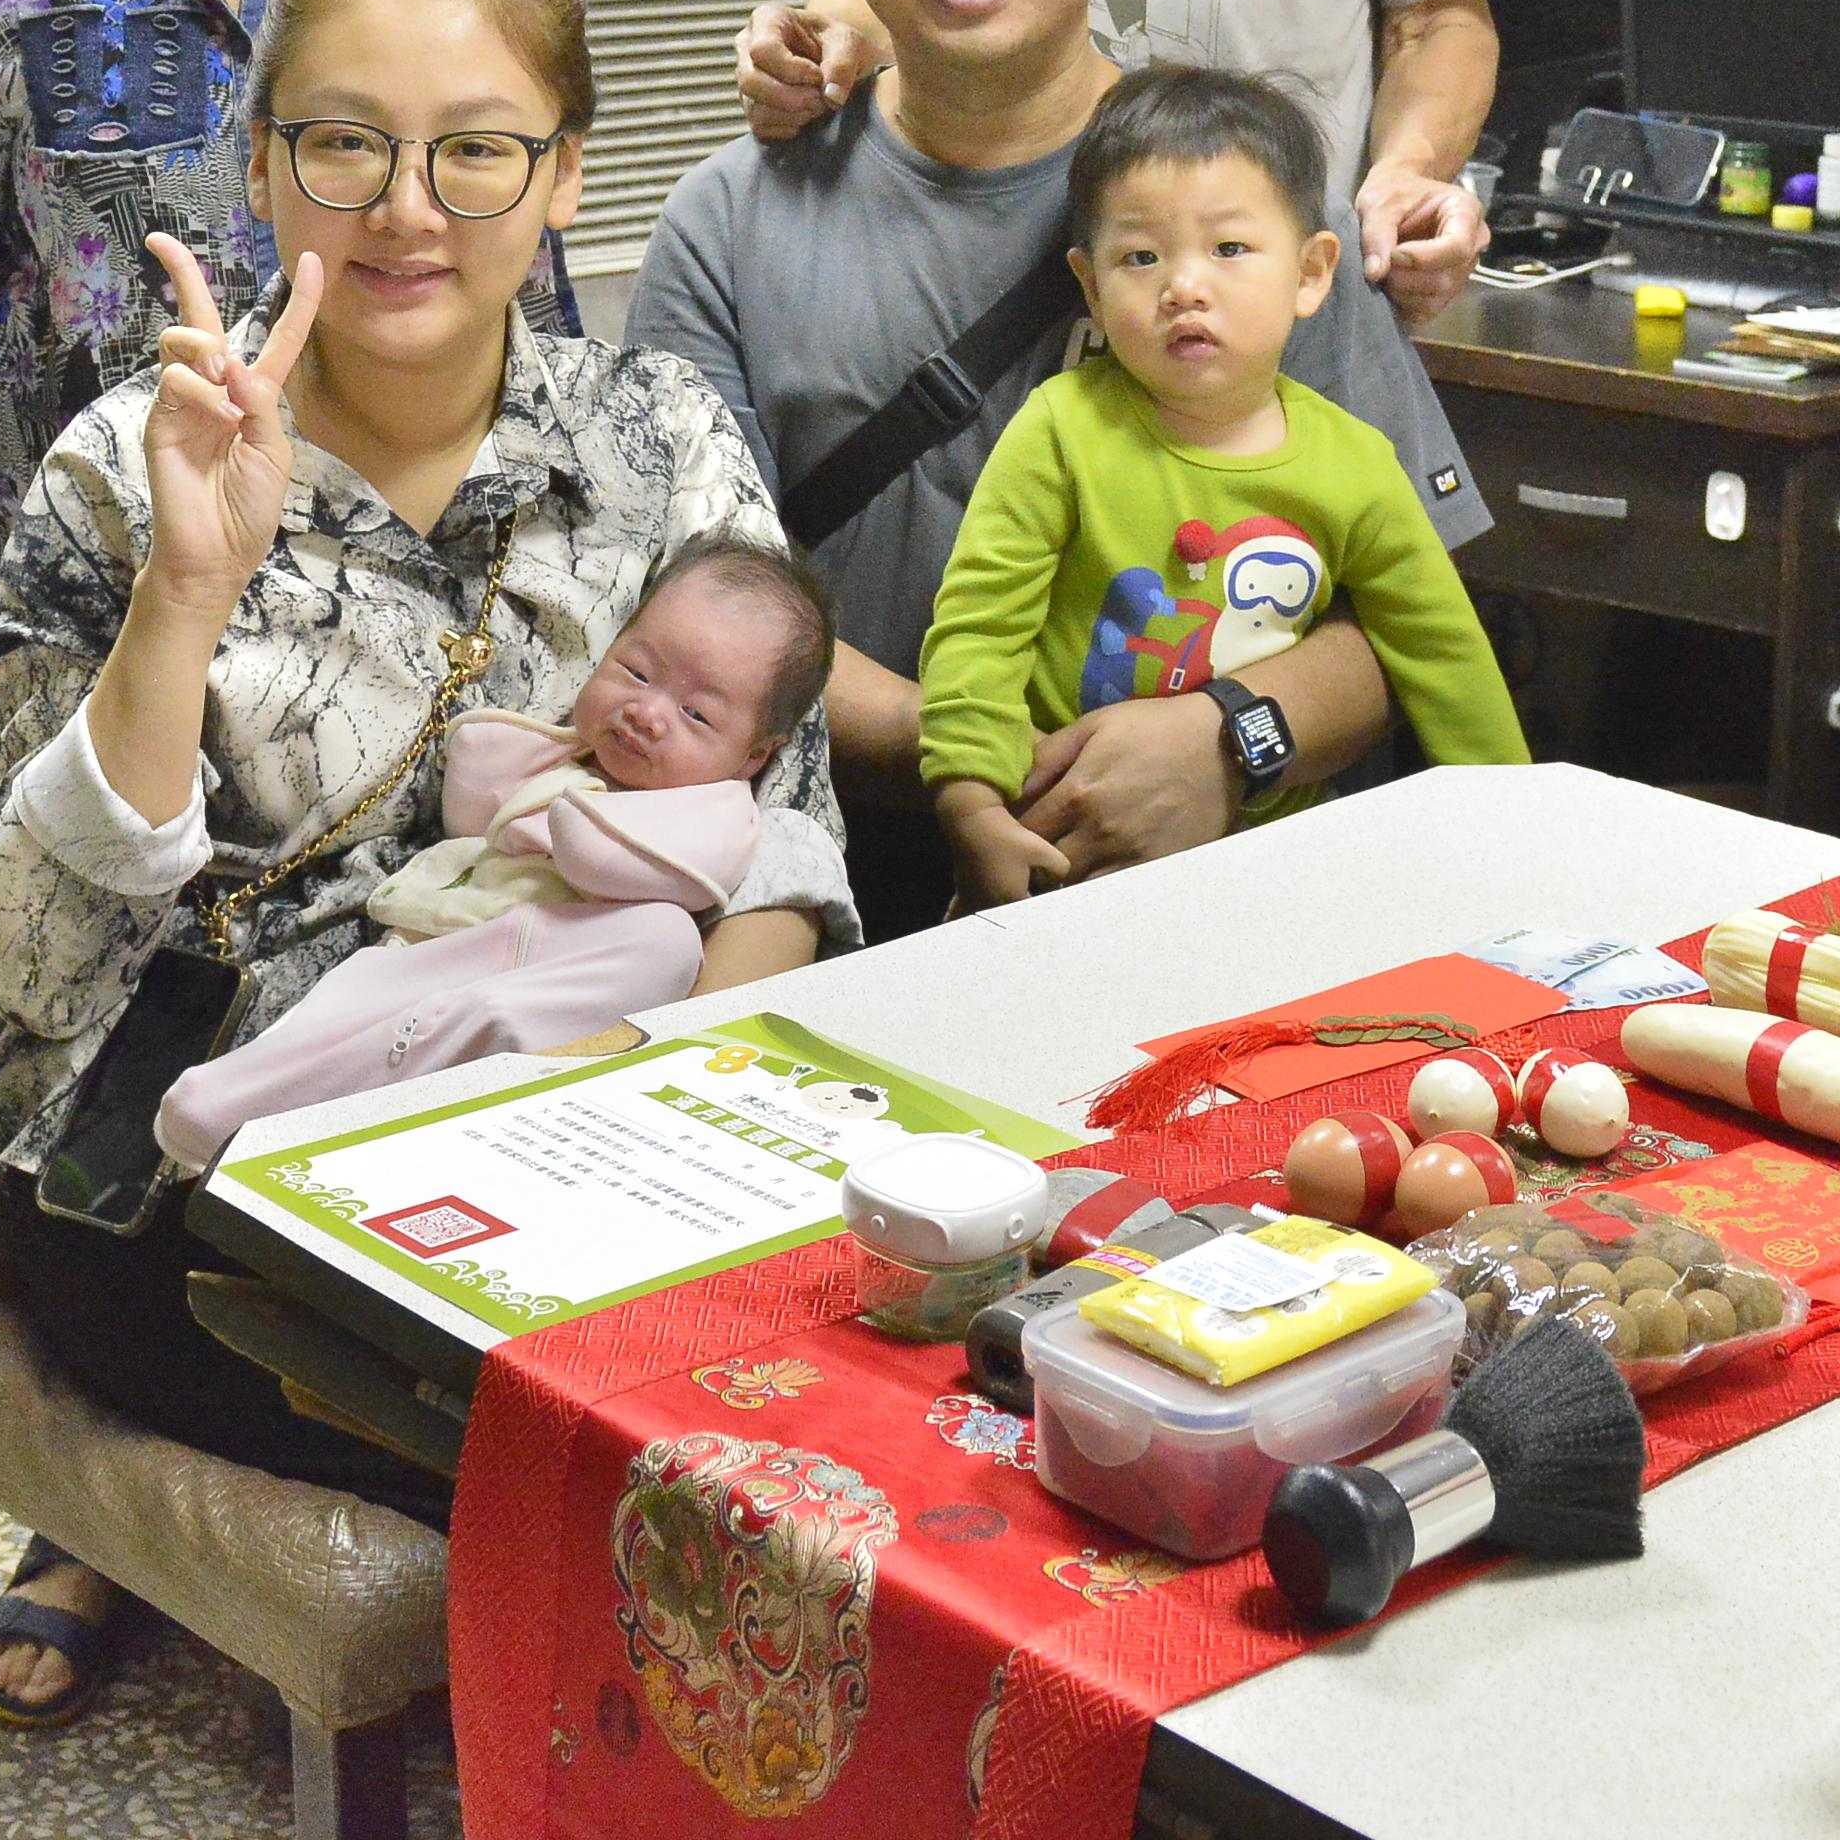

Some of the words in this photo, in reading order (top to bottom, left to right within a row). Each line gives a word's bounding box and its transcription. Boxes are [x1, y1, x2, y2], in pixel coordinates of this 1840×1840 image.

[1435, 469, 1457, 492] CAT
[1561, 942, 1620, 967] 1000
[1618, 980, 1698, 1001] 1000
